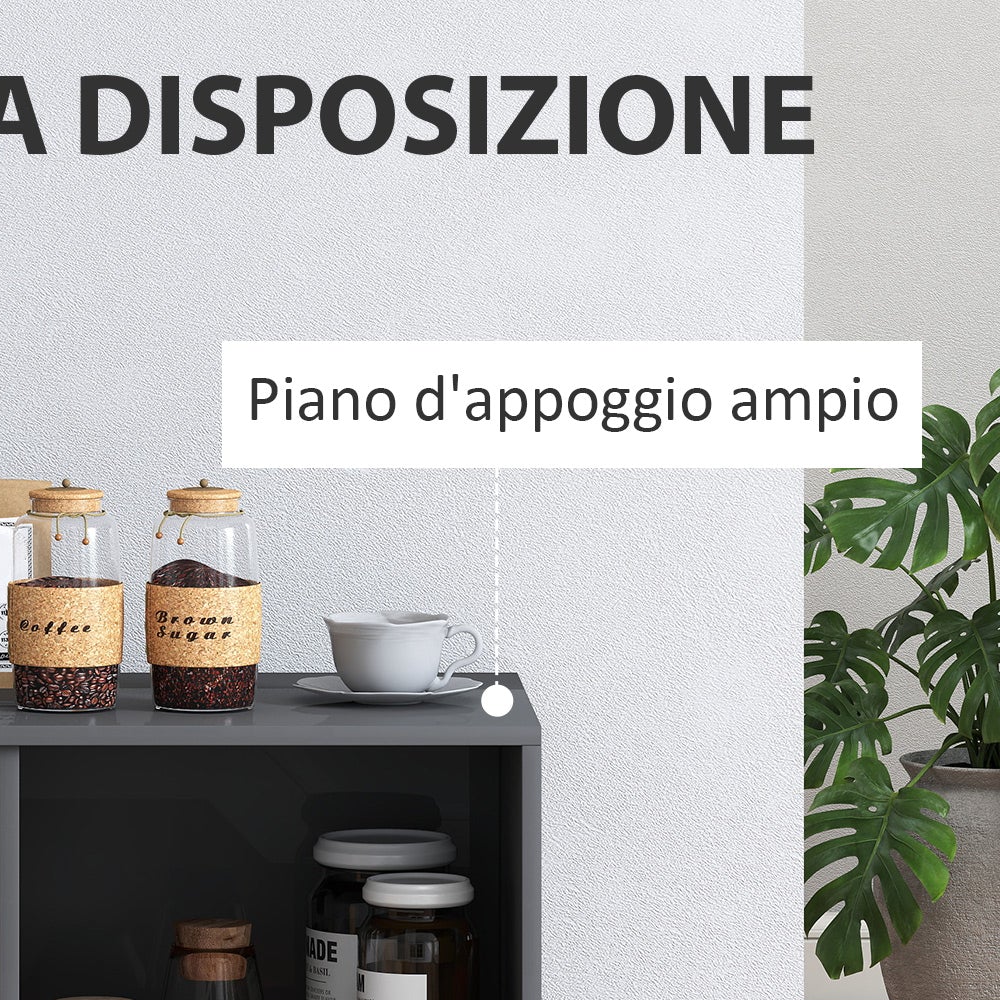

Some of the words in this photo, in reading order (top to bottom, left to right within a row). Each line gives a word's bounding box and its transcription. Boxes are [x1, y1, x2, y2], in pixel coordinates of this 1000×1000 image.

[155, 610, 234, 625] Brown
[19, 619, 91, 635] Coffee
[156, 625, 232, 642] Sugar
